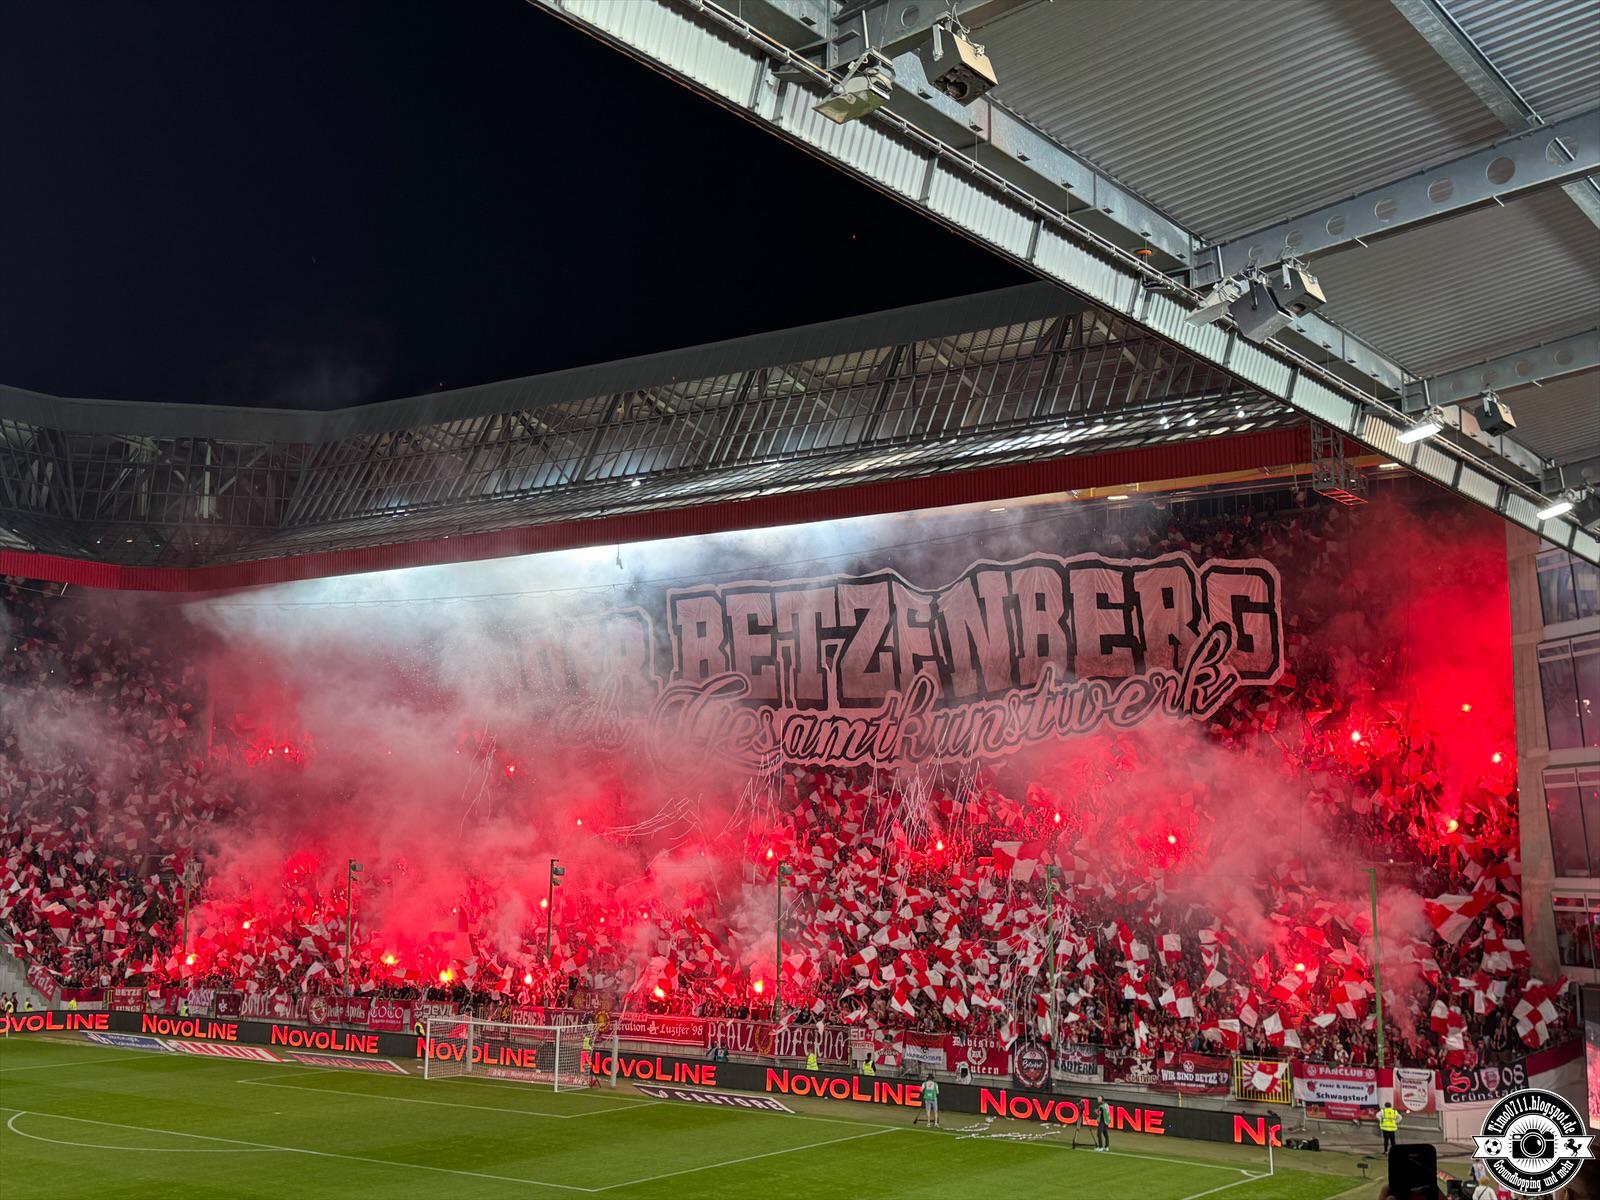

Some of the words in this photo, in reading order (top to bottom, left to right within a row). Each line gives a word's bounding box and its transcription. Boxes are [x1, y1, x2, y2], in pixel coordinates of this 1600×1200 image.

[667, 552, 1285, 710] BETZENBERG
[652, 621, 1242, 770] Gesamtkunstwerk
[142, 1013, 239, 1041] NOVOLINE
[271, 1024, 380, 1054] NOVOLINE
[659, 1022, 690, 1037] Luzifer
[707, 1021, 755, 1052] PFALZ
[774, 1026, 851, 1061] INFERNO
[416, 1037, 537, 1069] NOVOLINE
[580, 1050, 718, 1086] NOVOLINE
[765, 1067, 924, 1107] NOVOLINE
[1161, 1069, 1176, 1081] WIR
[1176, 1071, 1195, 1081] SIND
[1195, 1073, 1218, 1084] BETZE
[1319, 1067, 1364, 1078] FANCLUB
[674, 1091, 784, 1110] CASTORE
[979, 1087, 1166, 1135] NOVOLINE
[1315, 1092, 1369, 1102] Schwagstorf
